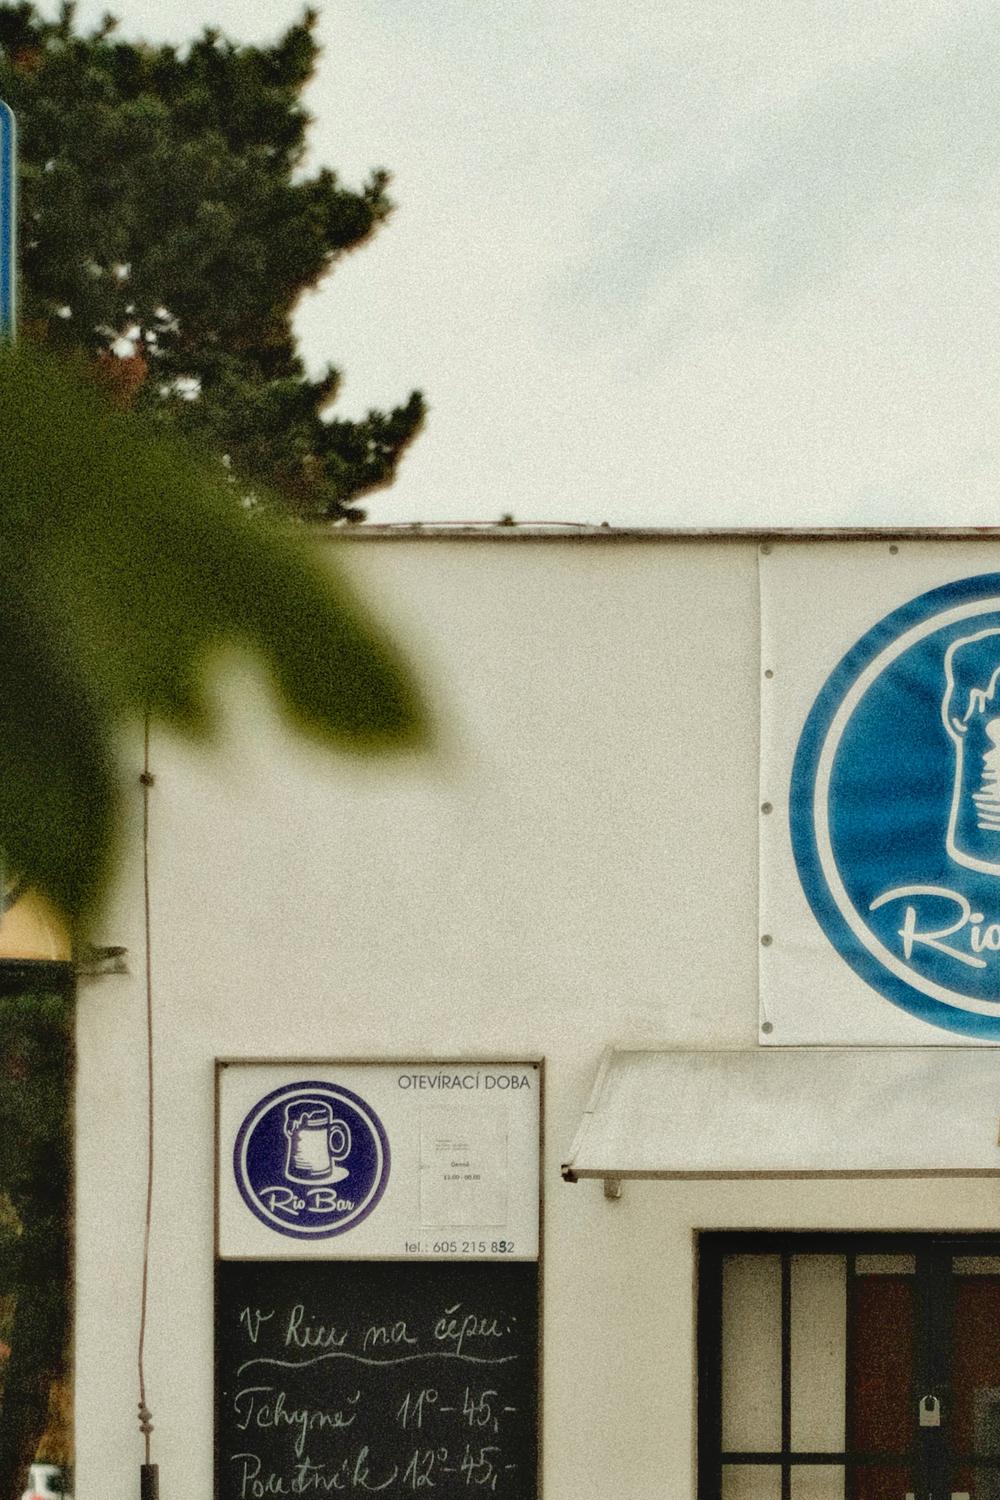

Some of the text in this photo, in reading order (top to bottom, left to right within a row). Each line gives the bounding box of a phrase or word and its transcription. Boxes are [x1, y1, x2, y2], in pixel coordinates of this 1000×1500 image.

[399, 1071, 531, 1090] OTEVÍRACÍ DOBA
[260, 1186, 356, 1216] Rio Bar
[405, 1241, 429, 1253] tel.:
[433, 1241, 457, 1253] 605
[462, 1241, 486, 1253] 215
[240, 1306, 275, 1343] V
[363, 1321, 416, 1351] na
